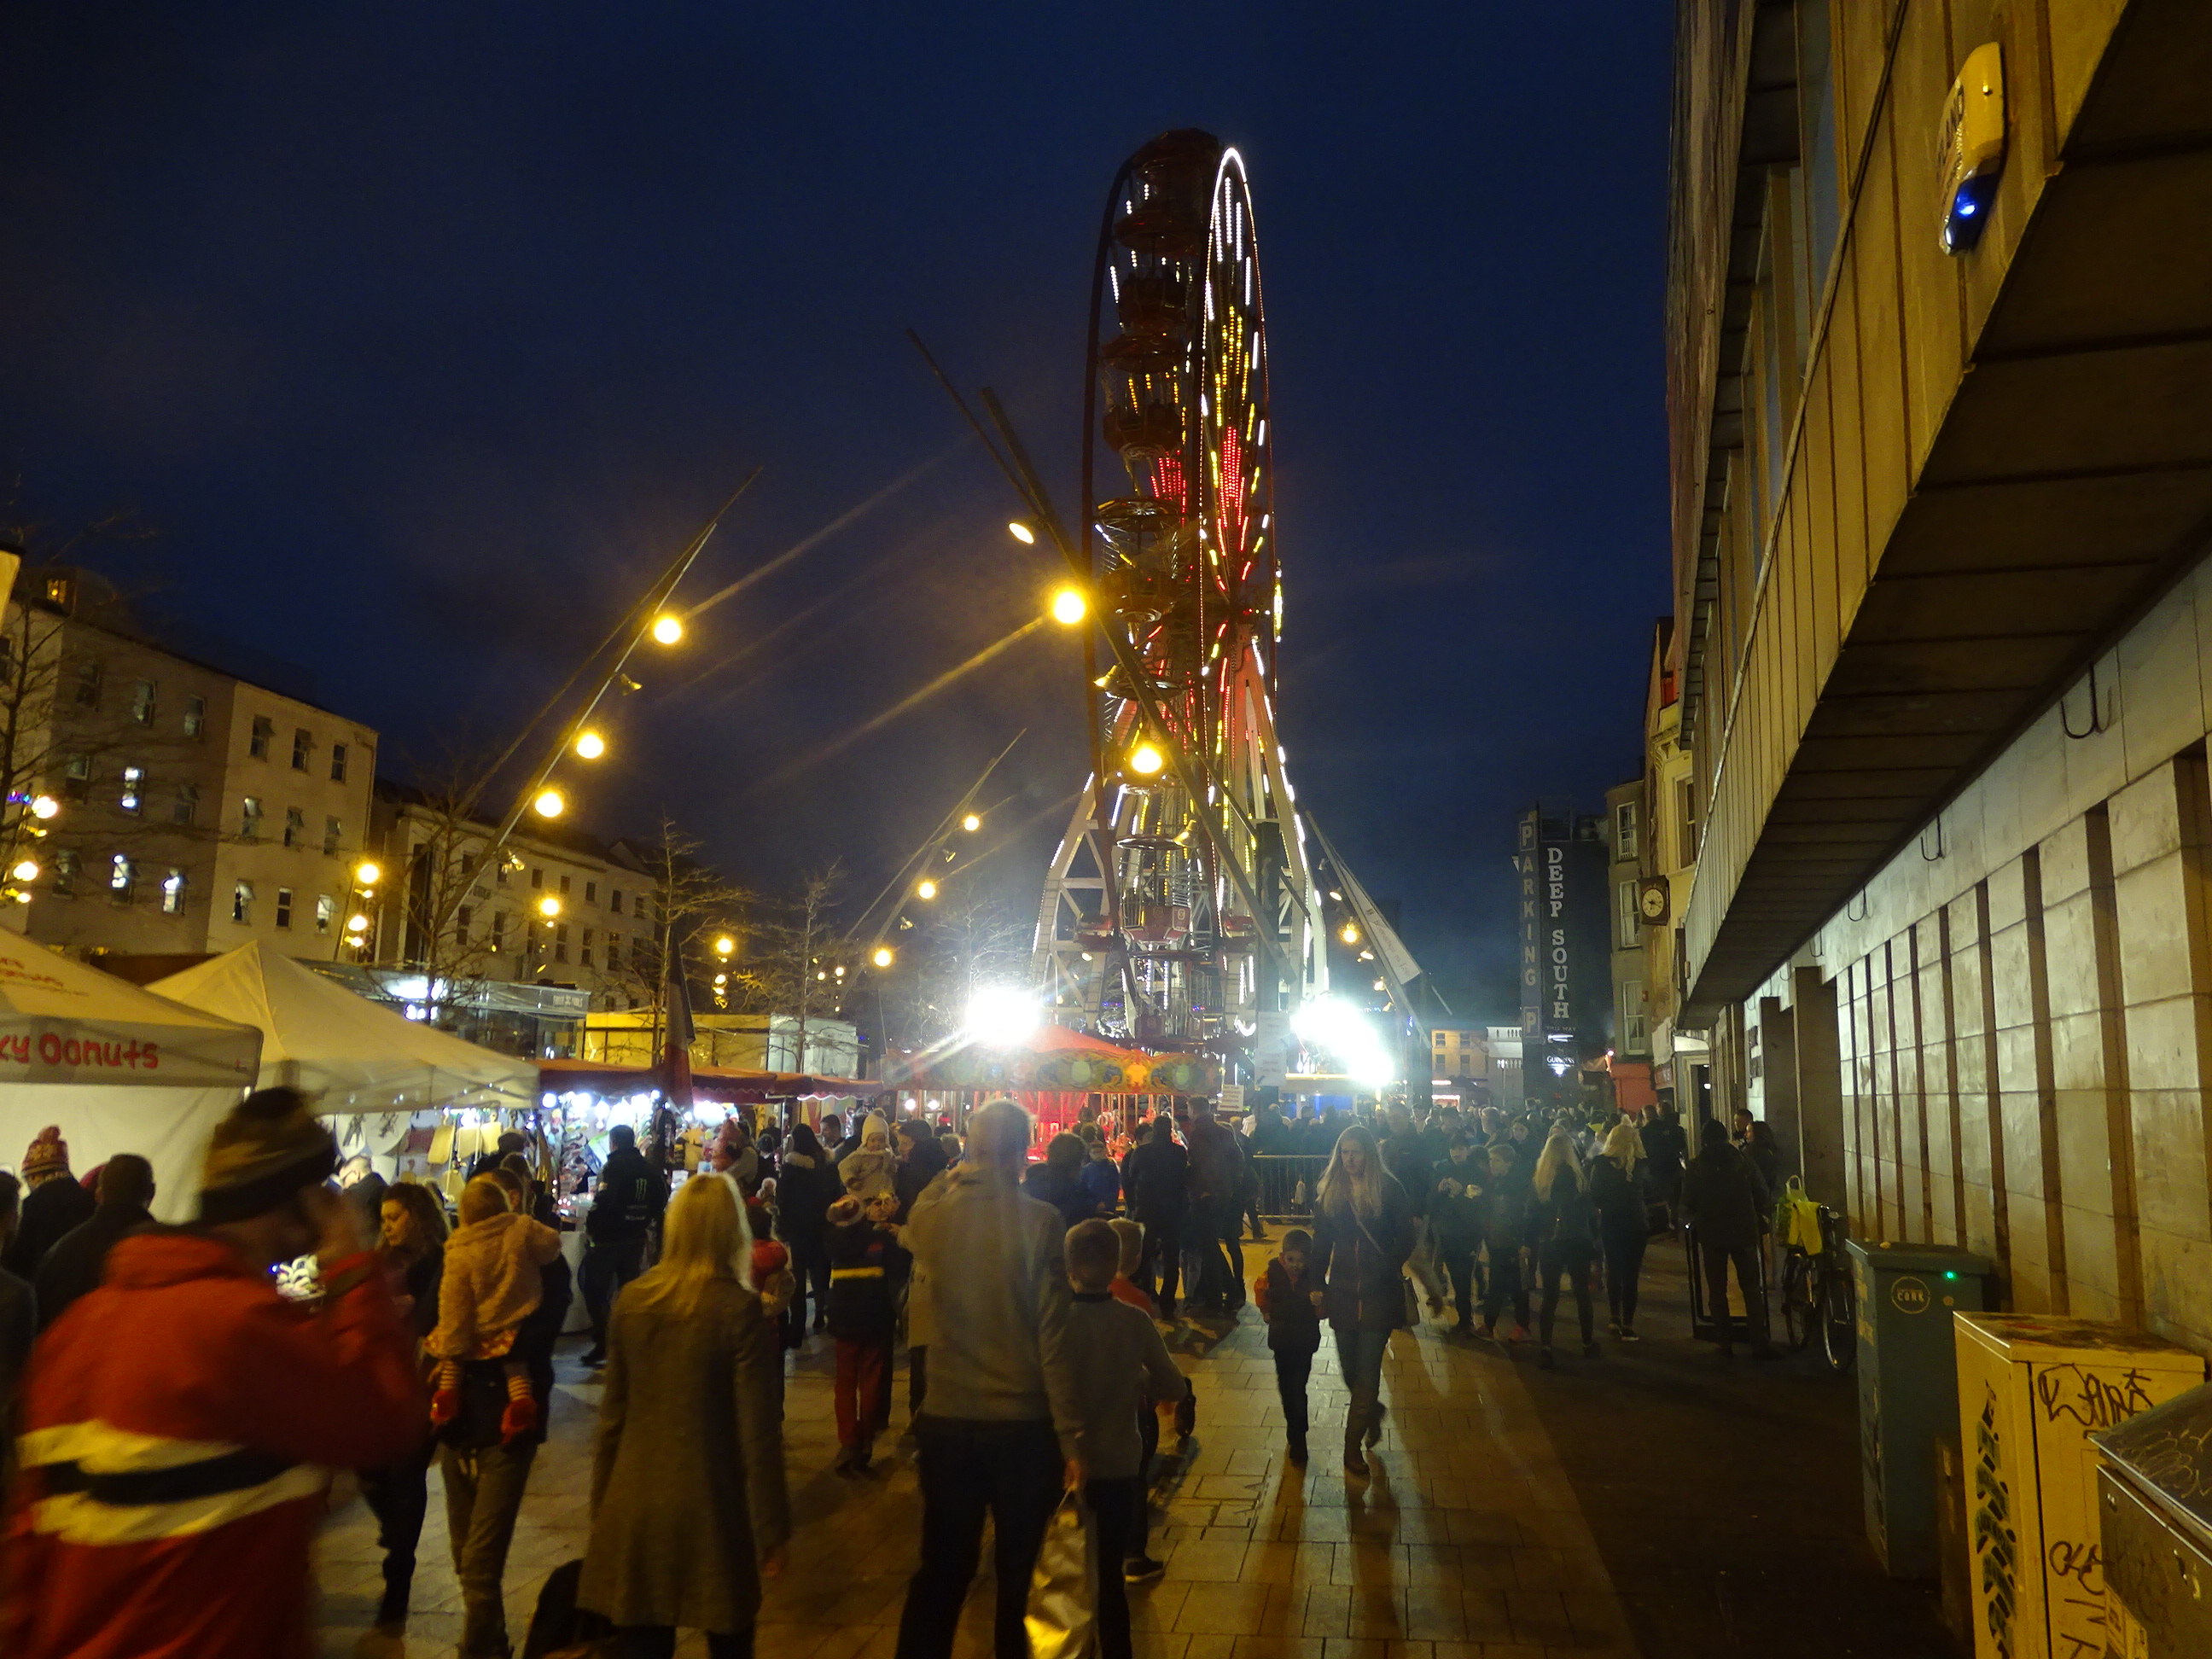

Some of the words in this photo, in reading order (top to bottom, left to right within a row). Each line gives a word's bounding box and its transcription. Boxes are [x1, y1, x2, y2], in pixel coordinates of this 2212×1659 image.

[1522, 825, 1535, 987] PARKING
[1547, 847, 1564, 917] DEEP
[1551, 928, 1569, 1019] SOUTH
[1525, 1011, 1537, 1033] P
[1897, 1289, 1924, 1302] CORK
